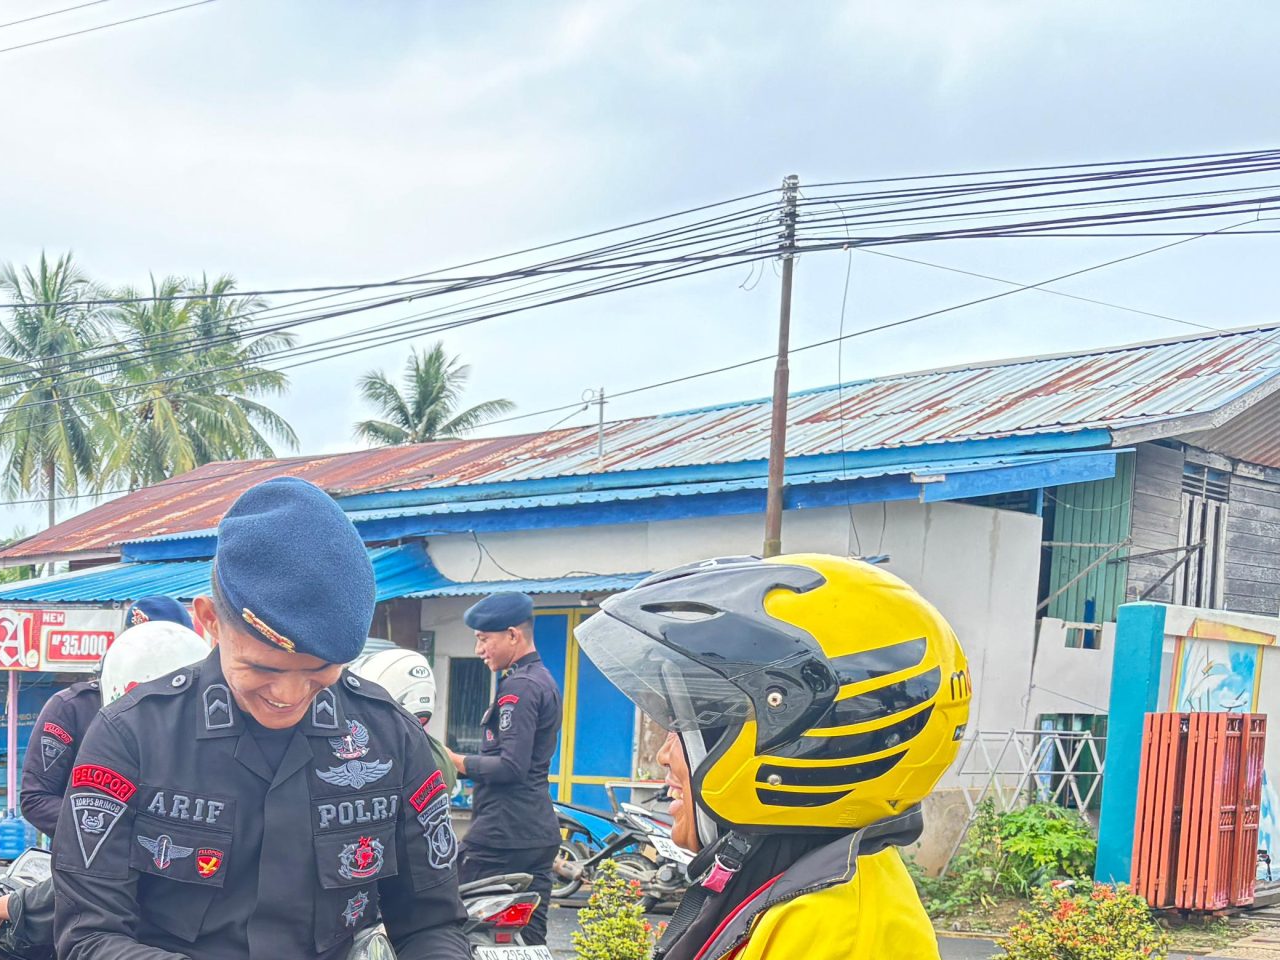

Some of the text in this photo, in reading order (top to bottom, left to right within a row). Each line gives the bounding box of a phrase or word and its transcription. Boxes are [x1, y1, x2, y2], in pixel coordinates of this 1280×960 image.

[42, 612, 65, 624] NEW
[75, 767, 129, 798] PELOPOR
[147, 792, 224, 824] ARIF
[318, 795, 398, 829] POLRI
